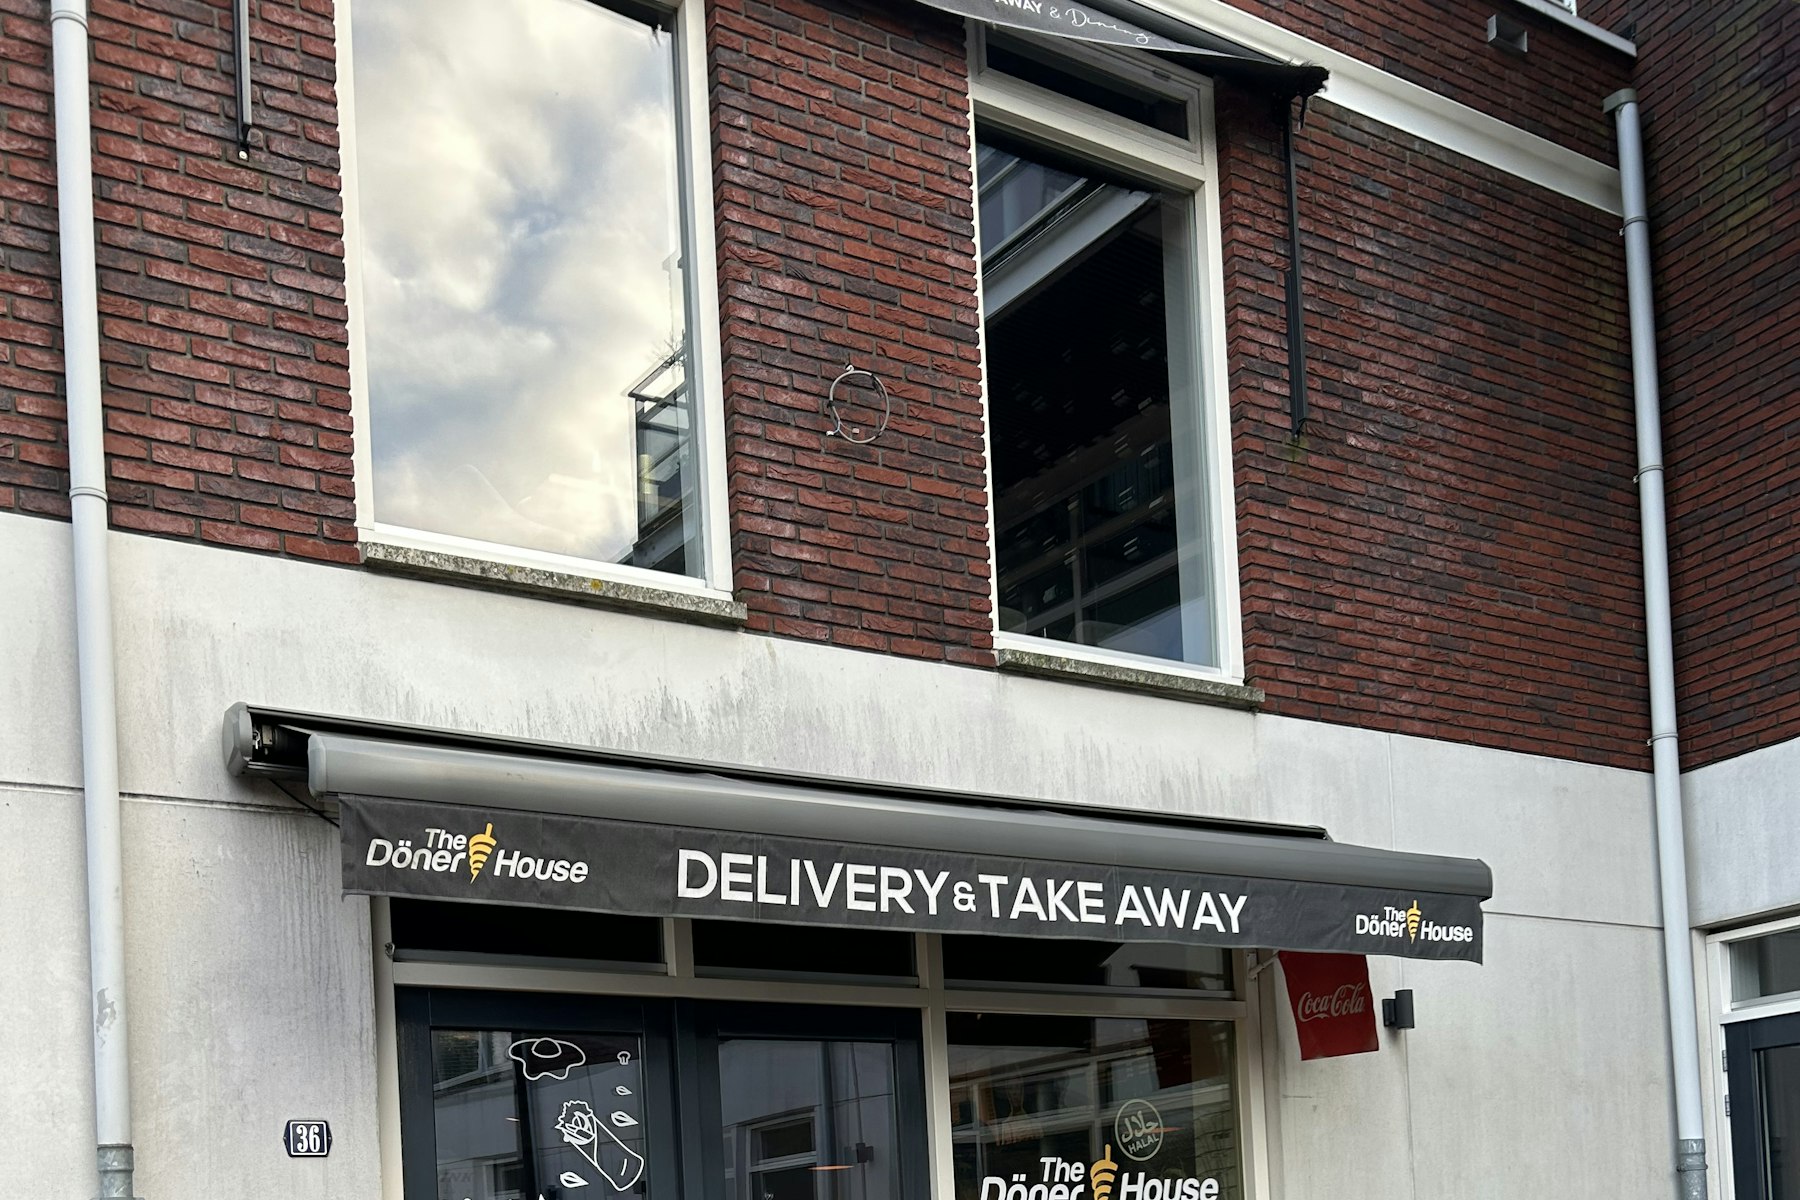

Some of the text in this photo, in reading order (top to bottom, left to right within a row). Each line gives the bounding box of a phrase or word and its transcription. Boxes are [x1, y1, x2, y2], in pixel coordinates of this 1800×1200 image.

[425, 828, 467, 850] The
[365, 838, 589, 884] Döner House
[677, 848, 1248, 934] DELIVERY & TAKE AWAY
[1355, 914, 1473, 943] Döner House
[1384, 906, 1406, 922] The
[1298, 982, 1366, 1022] Coca-Cola
[296, 1124, 321, 1153] 36
[1121, 1110, 1159, 1143] حلال
[1128, 1133, 1160, 1154] HALAL
[1039, 1156, 1085, 1183] The
